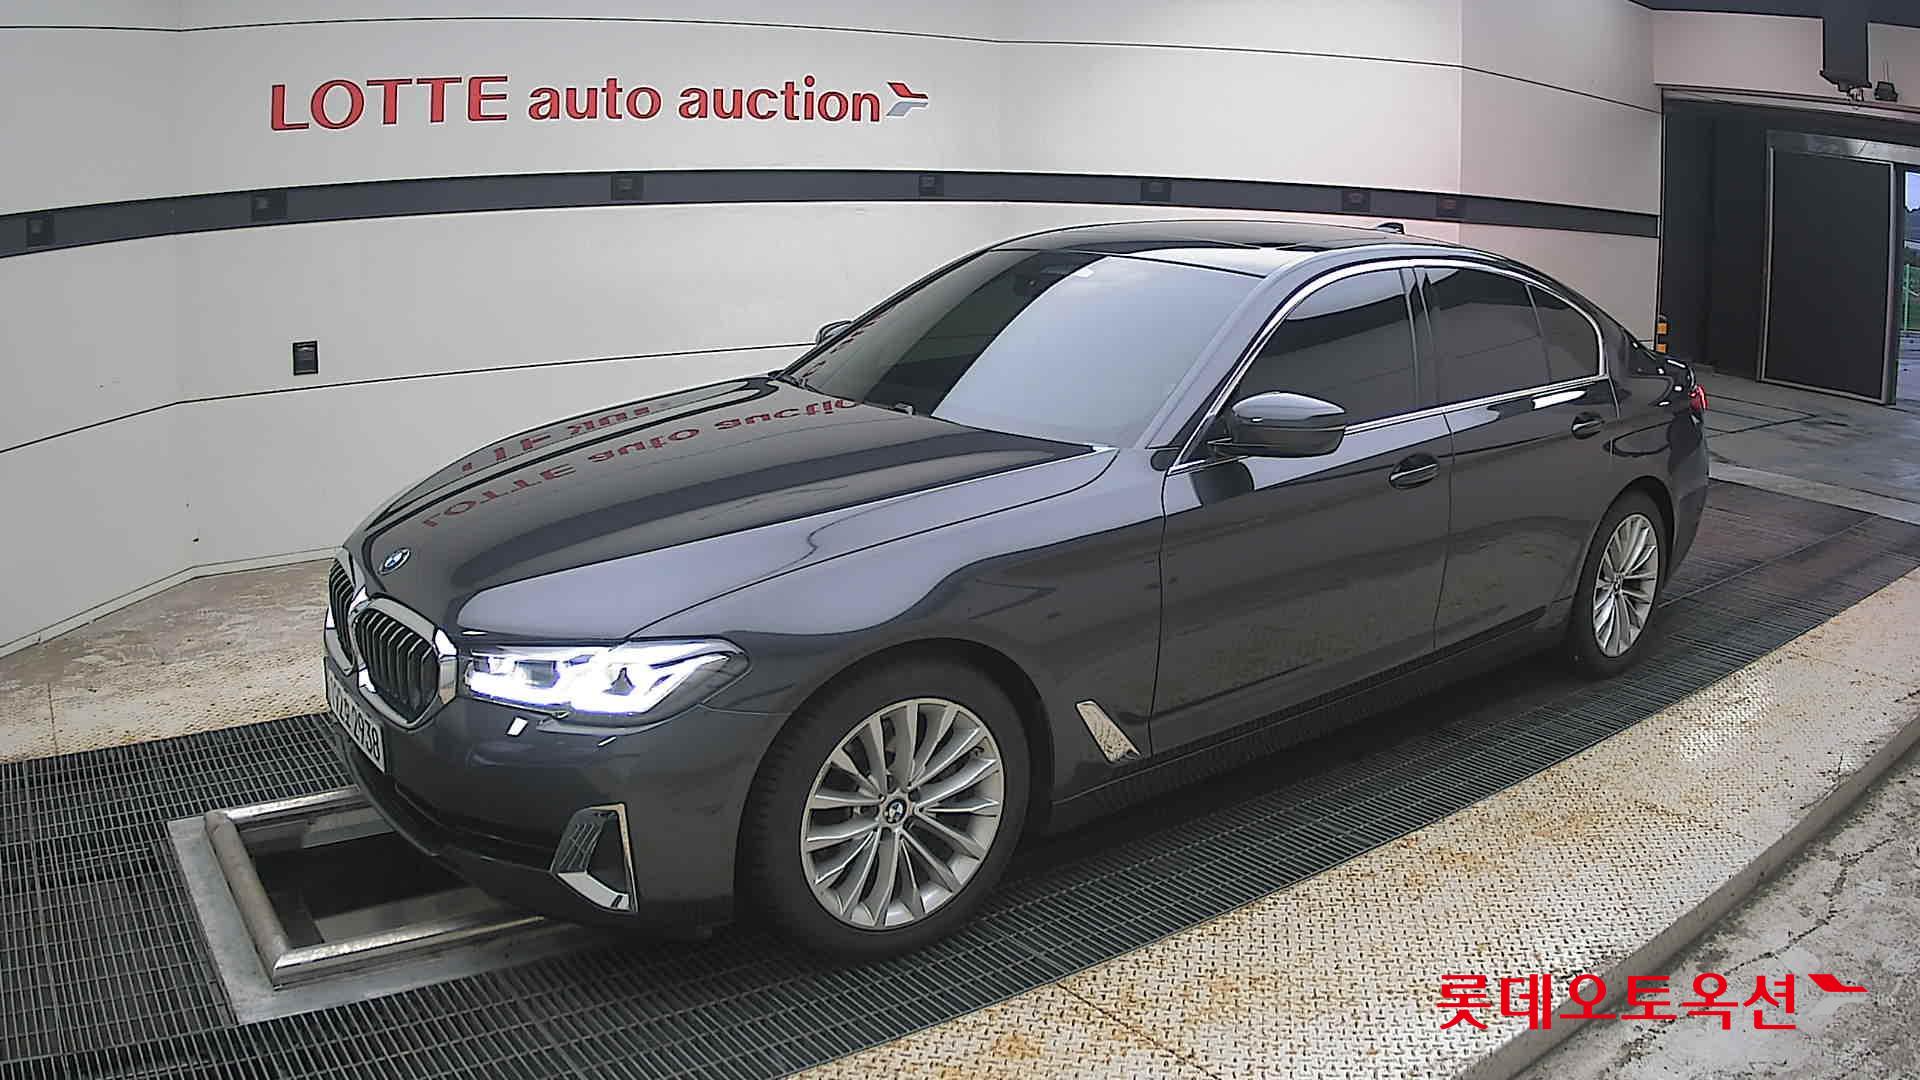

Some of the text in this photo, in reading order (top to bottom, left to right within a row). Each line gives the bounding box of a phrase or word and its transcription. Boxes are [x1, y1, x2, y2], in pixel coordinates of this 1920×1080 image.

[270, 74, 881, 131] LOTTE auto auction
